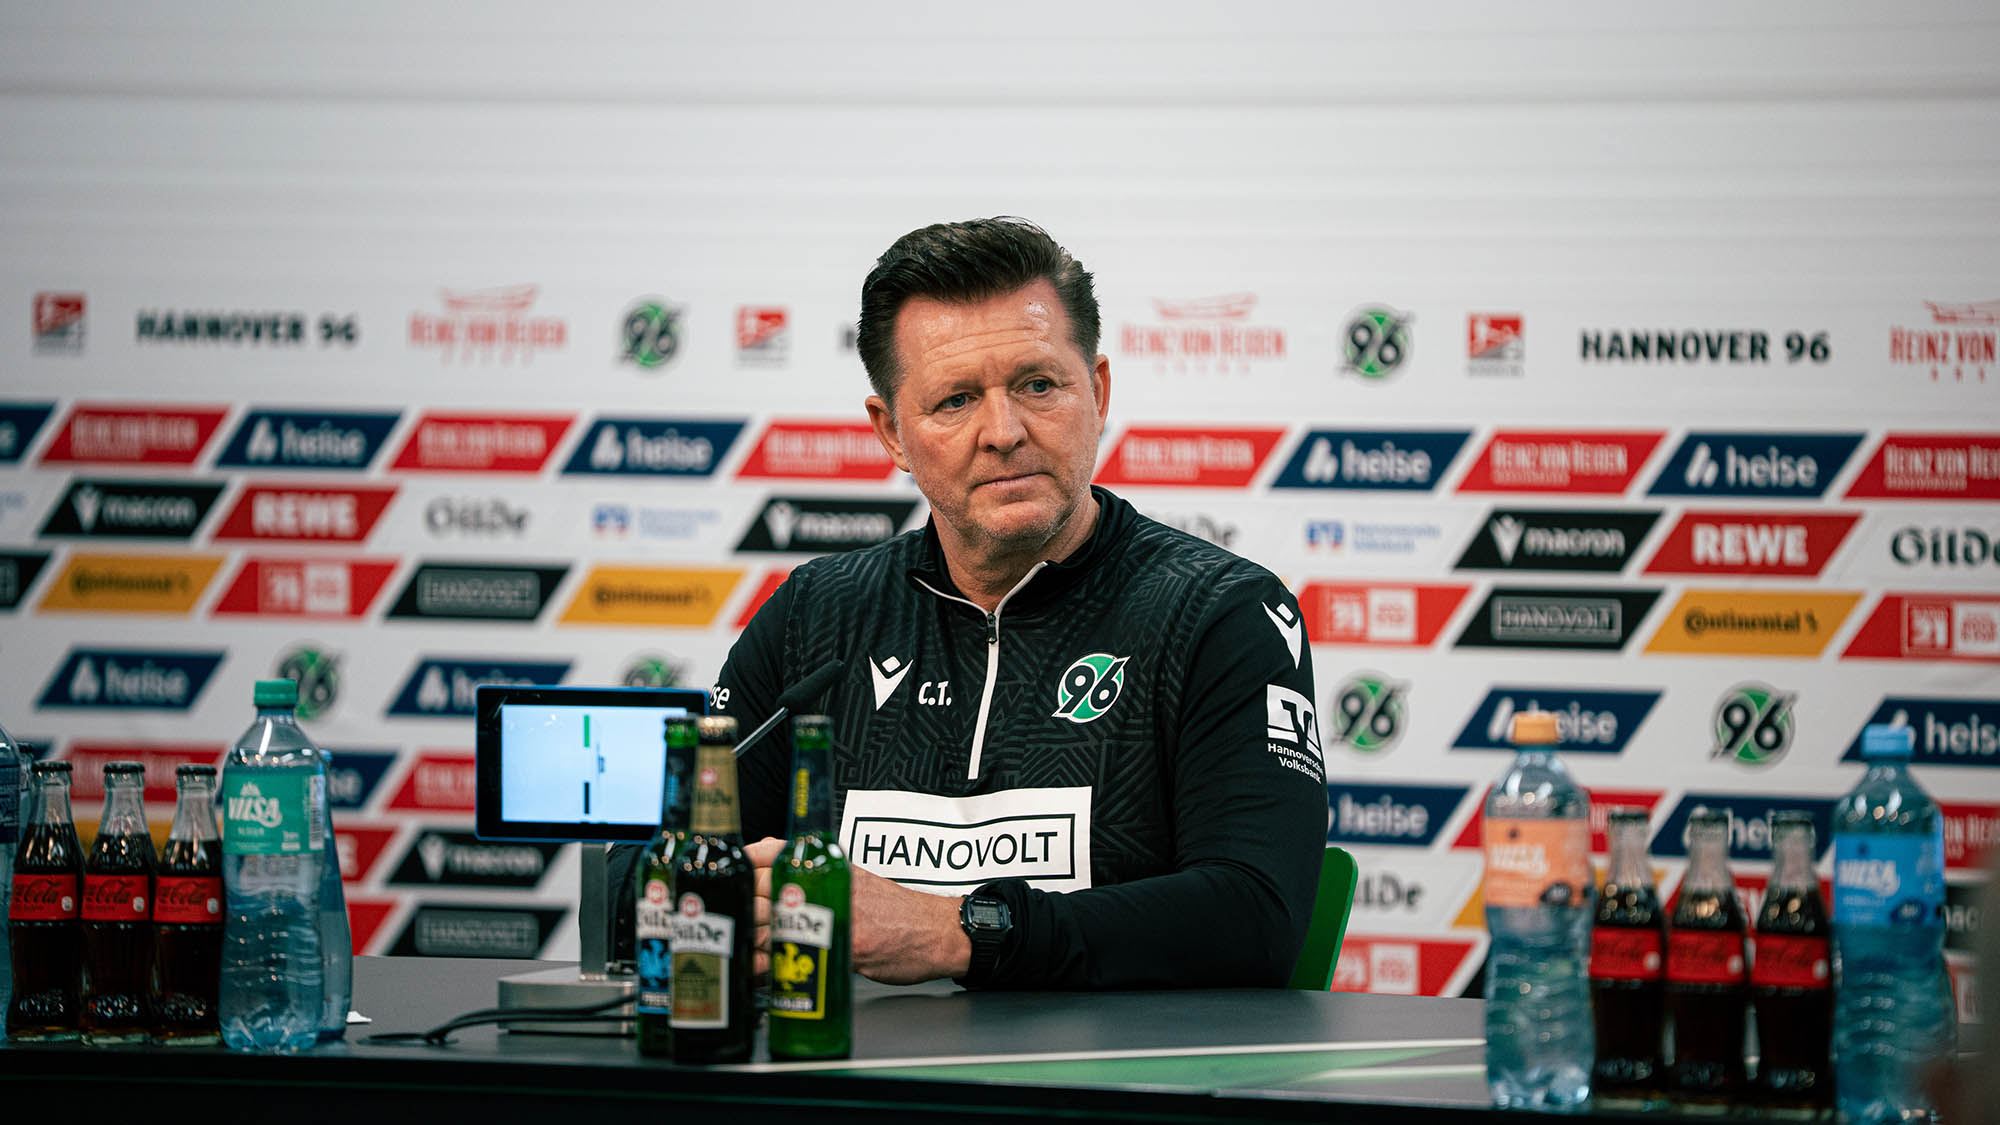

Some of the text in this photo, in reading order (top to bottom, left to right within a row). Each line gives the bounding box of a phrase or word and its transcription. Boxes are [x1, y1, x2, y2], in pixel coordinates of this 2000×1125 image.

[137, 311, 358, 343] HANNOVER 96
[1338, 312, 1414, 373] 96
[1581, 331, 1831, 363] HANNOVER 96
[1889, 326, 1996, 363] HEINZ VON
[282, 421, 366, 464] heise
[626, 428, 713, 471] heise
[1342, 441, 1432, 483] heise
[1727, 446, 1818, 487] heise
[253, 492, 358, 536] REWE
[798, 513, 894, 541] macron
[1525, 529, 1625, 556] macron
[1692, 525, 1809, 565] REWE
[1685, 609, 1800, 639] Continental
[918, 680, 952, 706] C.T.
[1054, 657, 1129, 715] 96
[1333, 681, 1410, 743] 96
[1711, 694, 1797, 759] 96
[1926, 714, 2000, 753] heis
[1339, 796, 1428, 837] heise
[862, 831, 1057, 870] HANOVOLT
